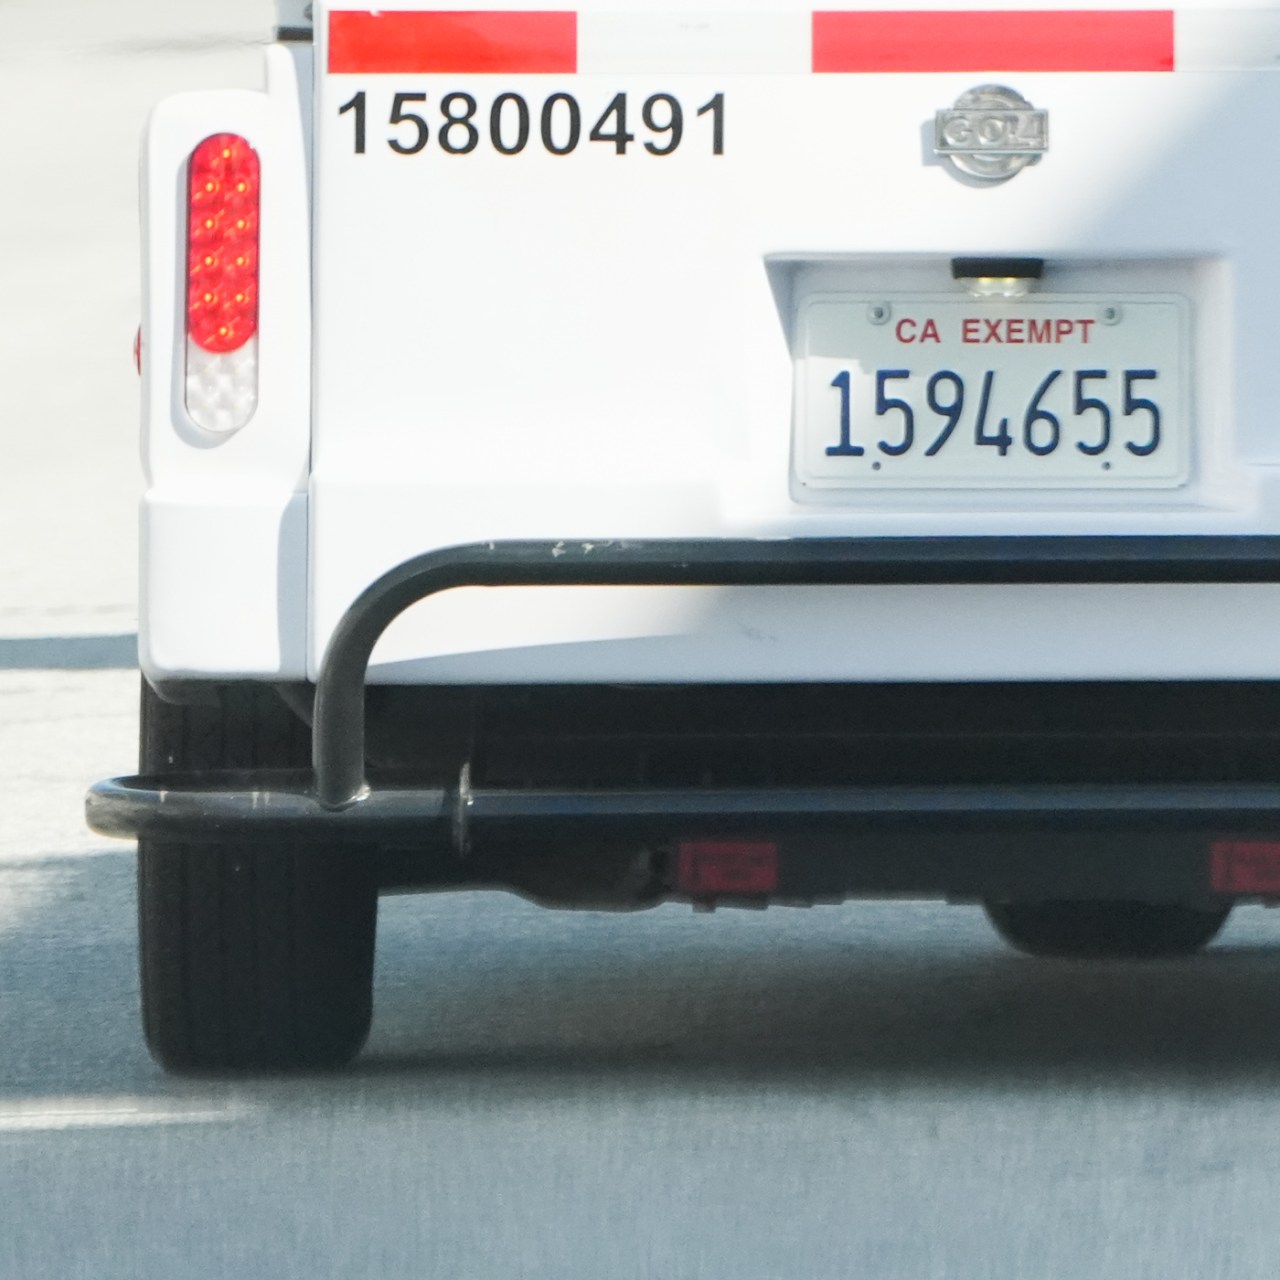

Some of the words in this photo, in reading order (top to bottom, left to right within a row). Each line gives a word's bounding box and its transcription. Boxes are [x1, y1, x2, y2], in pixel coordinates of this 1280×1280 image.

[337, 89, 726, 157] 15800491
[894, 317, 942, 345] CA
[961, 317, 1096, 345] EXEMPT
[824, 368, 1162, 457] 1594655
